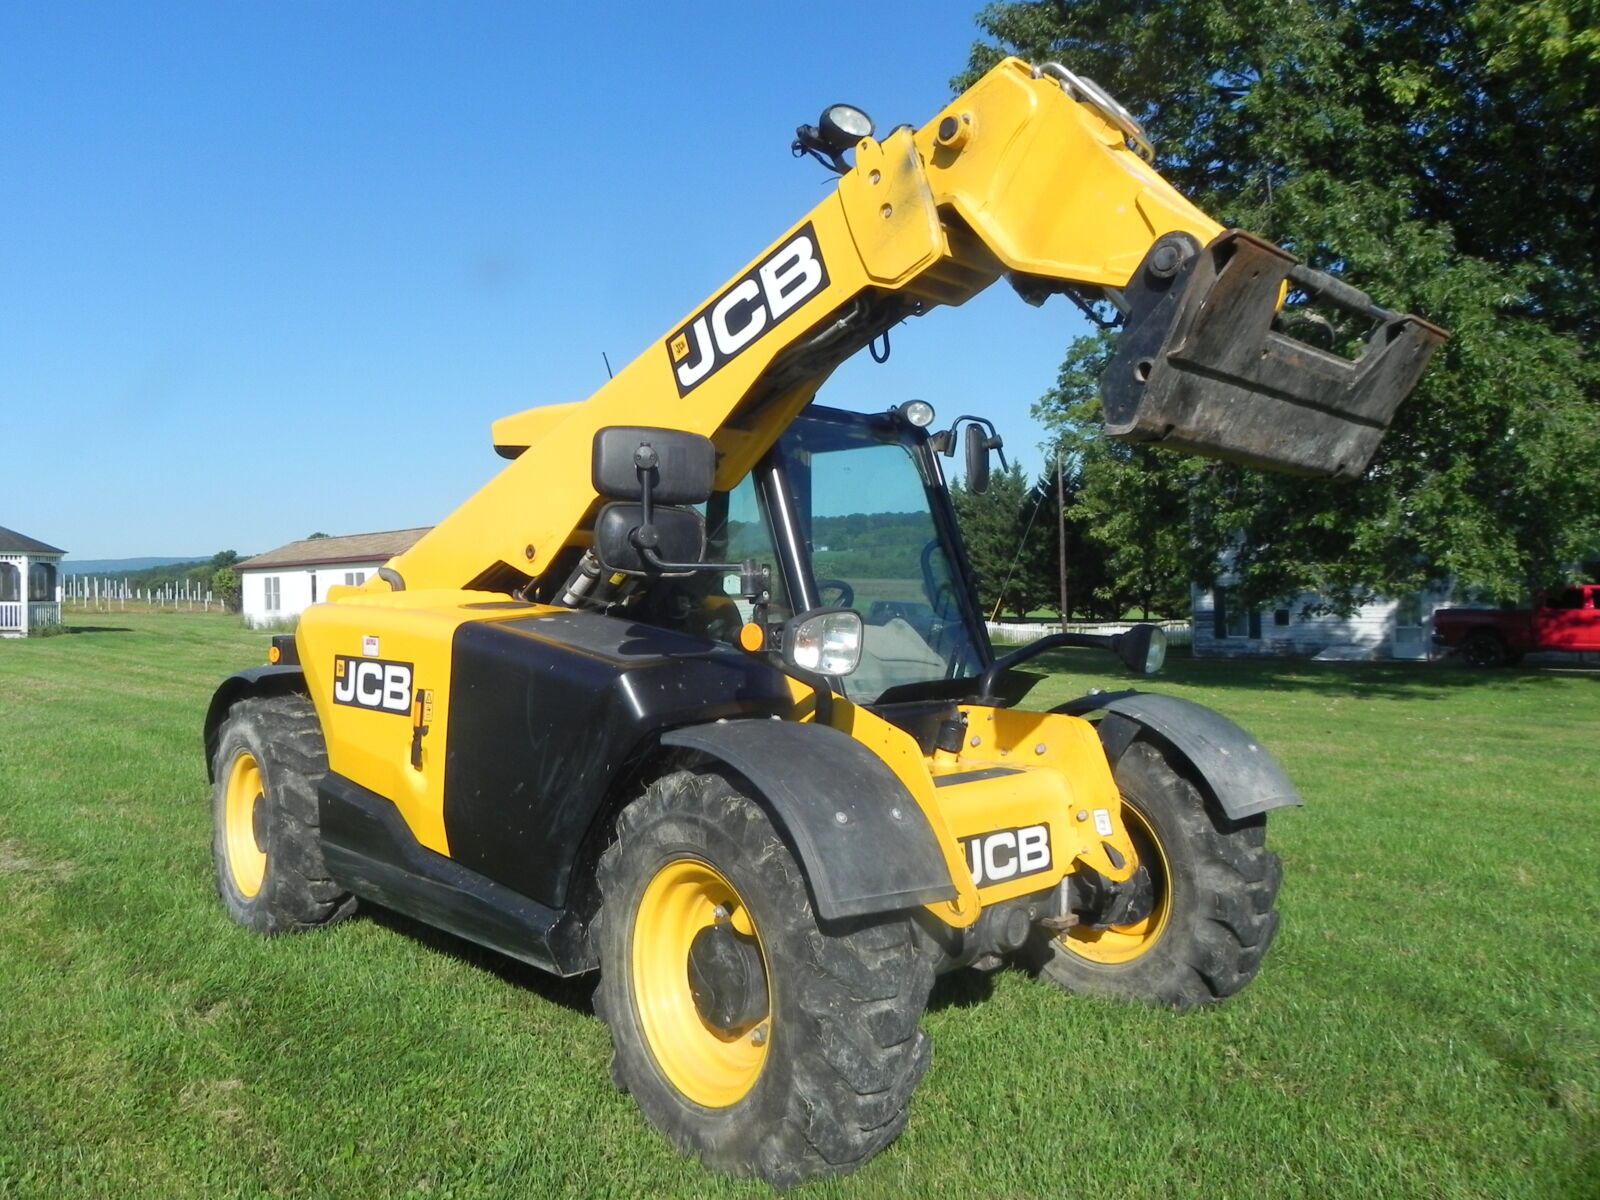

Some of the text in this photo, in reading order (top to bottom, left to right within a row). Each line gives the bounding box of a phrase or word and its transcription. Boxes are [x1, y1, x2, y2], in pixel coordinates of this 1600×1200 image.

[677, 236, 822, 387] JCB
[335, 661, 411, 711] JCB
[971, 825, 1050, 885] JCB
